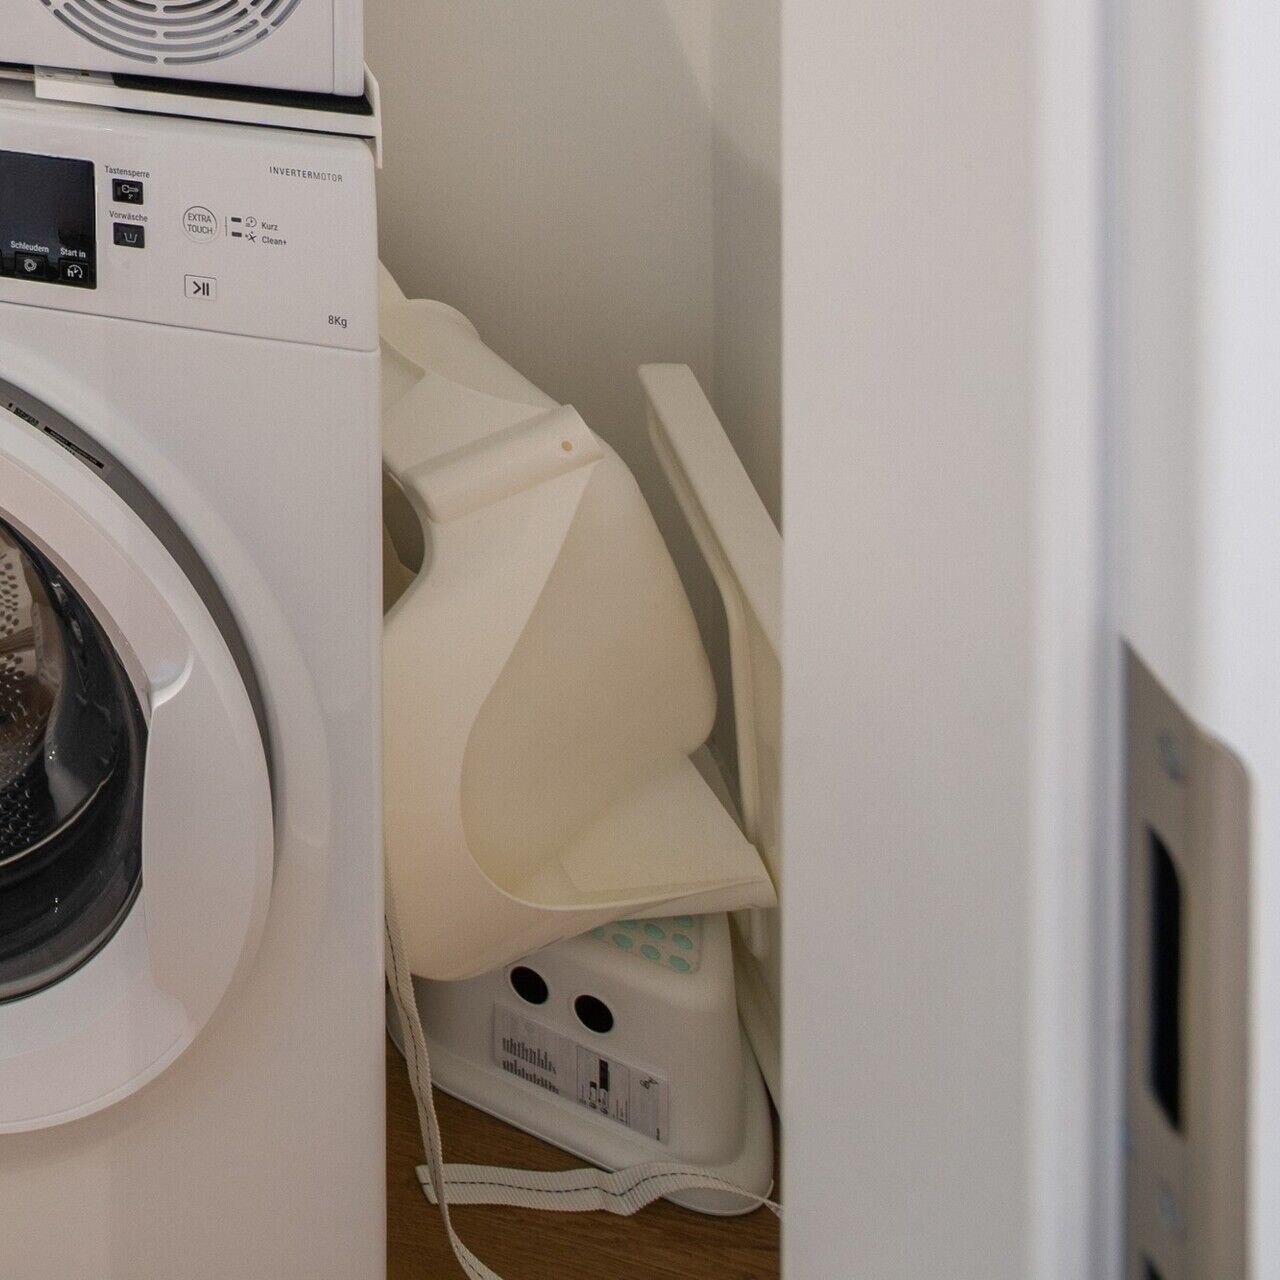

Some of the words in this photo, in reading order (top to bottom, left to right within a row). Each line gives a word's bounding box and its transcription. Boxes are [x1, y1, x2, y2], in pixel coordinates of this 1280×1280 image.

[104, 165, 151, 179] Tastensperre
[269, 166, 343, 182] INVERTERMOTOR
[108, 210, 149, 223] Vorwäsche
[187, 212, 212, 224] EXTRA
[186, 223, 214, 235] TOUCH
[261, 222, 279, 232] Kurz
[261, 235, 287, 246] Clean+
[10, 240, 50, 254] Schleudern
[59, 247, 78, 258] Start
[78, 249, 86, 258] in
[328, 314, 348, 329] 8Kg
